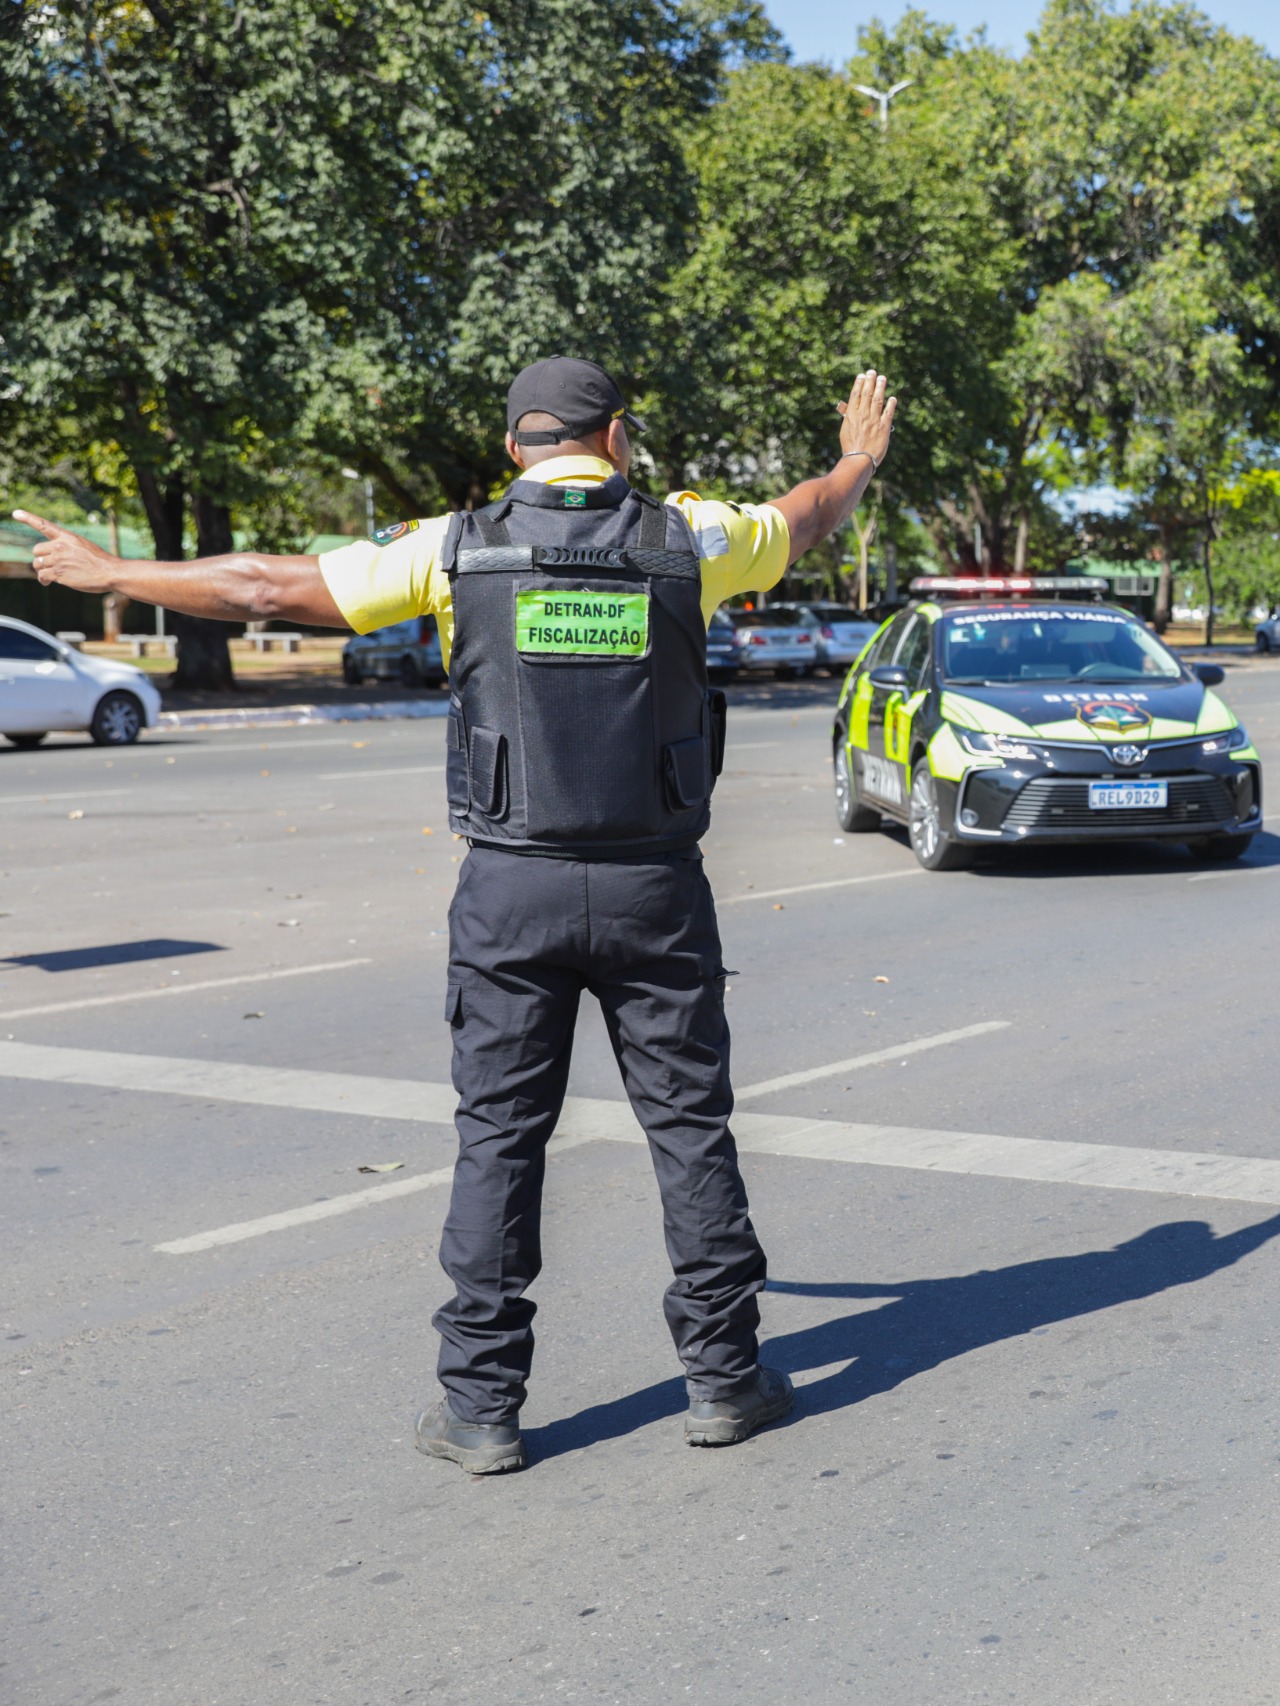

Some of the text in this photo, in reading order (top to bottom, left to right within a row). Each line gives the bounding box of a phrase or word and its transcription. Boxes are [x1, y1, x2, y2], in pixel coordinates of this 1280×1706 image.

[544, 602, 625, 618] DETRAN-DF
[953, 611, 1063, 625] SEGURANÇA
[528, 626, 641, 649] FISCALIZAÇÃO
[1042, 692, 1149, 703] DETRAN
[1098, 790, 1160, 805] REL9D29
